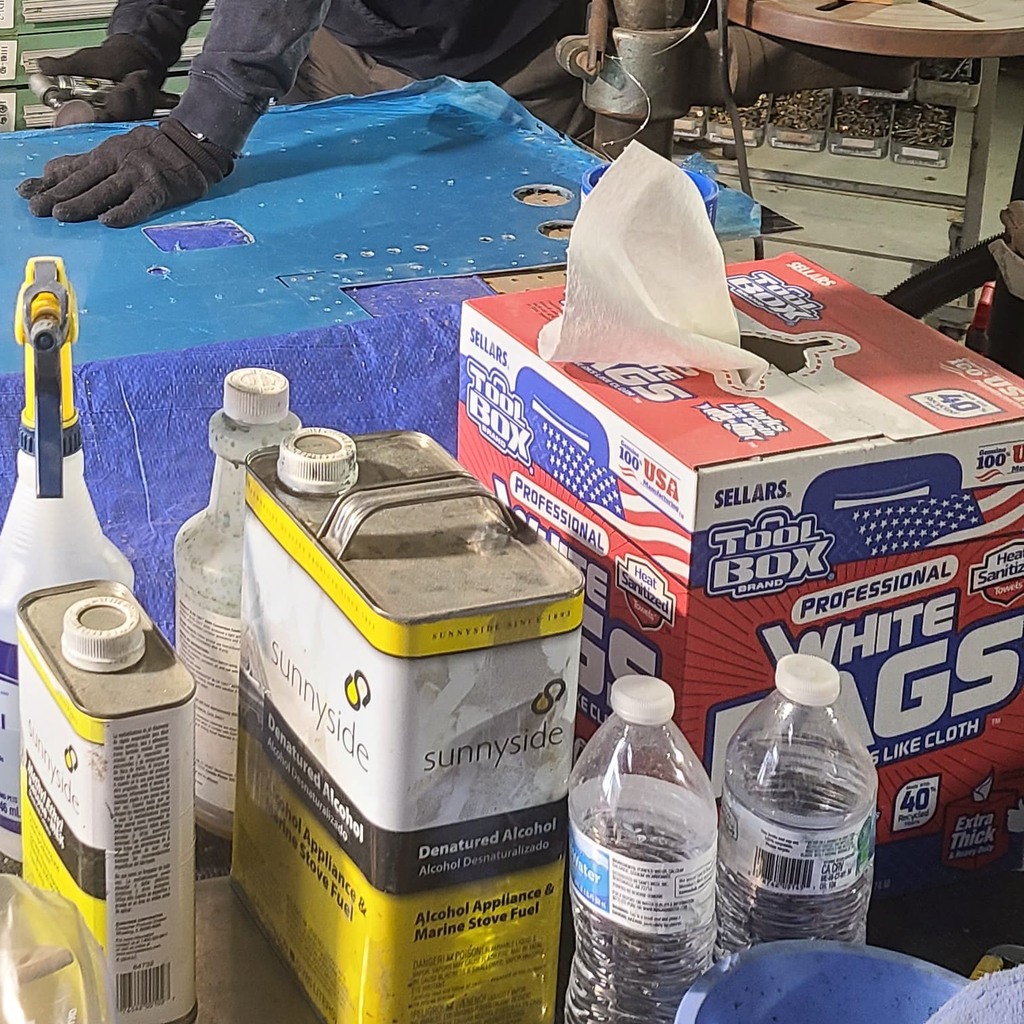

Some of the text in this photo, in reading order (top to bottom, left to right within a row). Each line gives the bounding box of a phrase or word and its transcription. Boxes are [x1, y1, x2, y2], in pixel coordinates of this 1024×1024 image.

[755, 273, 817, 313] TOOL
[787, 261, 837, 287] SELLARS
[727, 276, 815, 320] BOX
[469, 327, 507, 367] SELLARS
[467, 364, 524, 427] TOOL
[468, 391, 531, 463] BOX
[482, 425, 507, 448] BRAND
[644, 457, 679, 502] USA
[714, 480, 787, 509] SELLARS
[515, 477, 605, 553] PROFESSIONAL
[714, 518, 821, 555] TOOL
[635, 566, 657, 590] Heat
[714, 537, 833, 590] BOX
[620, 570, 669, 614] Sanitized
[738, 579, 783, 593] BRAND
[800, 562, 952, 619] PROFESSIONAL
[994, 582, 1023, 596] Towels
[432, 623, 500, 640] SUNNYSIDE
[762, 591, 958, 664] WHITE
[271, 640, 369, 773] sunnyside
[424, 721, 564, 772] sunnyside
[883, 737, 922, 762] LIKE
[925, 718, 980, 748] CLOTH
[267, 738, 349, 843] Alcohol Desnaturalizado
[268, 712, 365, 844] Denatured Alcohol
[898, 810, 930, 823] Recycled
[956, 813, 995, 832] Extra
[418, 817, 557, 860] Denatured Alcohol
[419, 840, 550, 877] Alcohol Desnaturalizado
[950, 827, 996, 850] Thick
[299, 843, 330, 891] Stove
[330, 886, 354, 922] Fuel
[303, 828, 357, 903] Appliance
[358, 896, 367, 917] &
[414, 902, 540, 943] Marine Stove Fuel
[415, 883, 555, 925] Alcohol Appliance &
